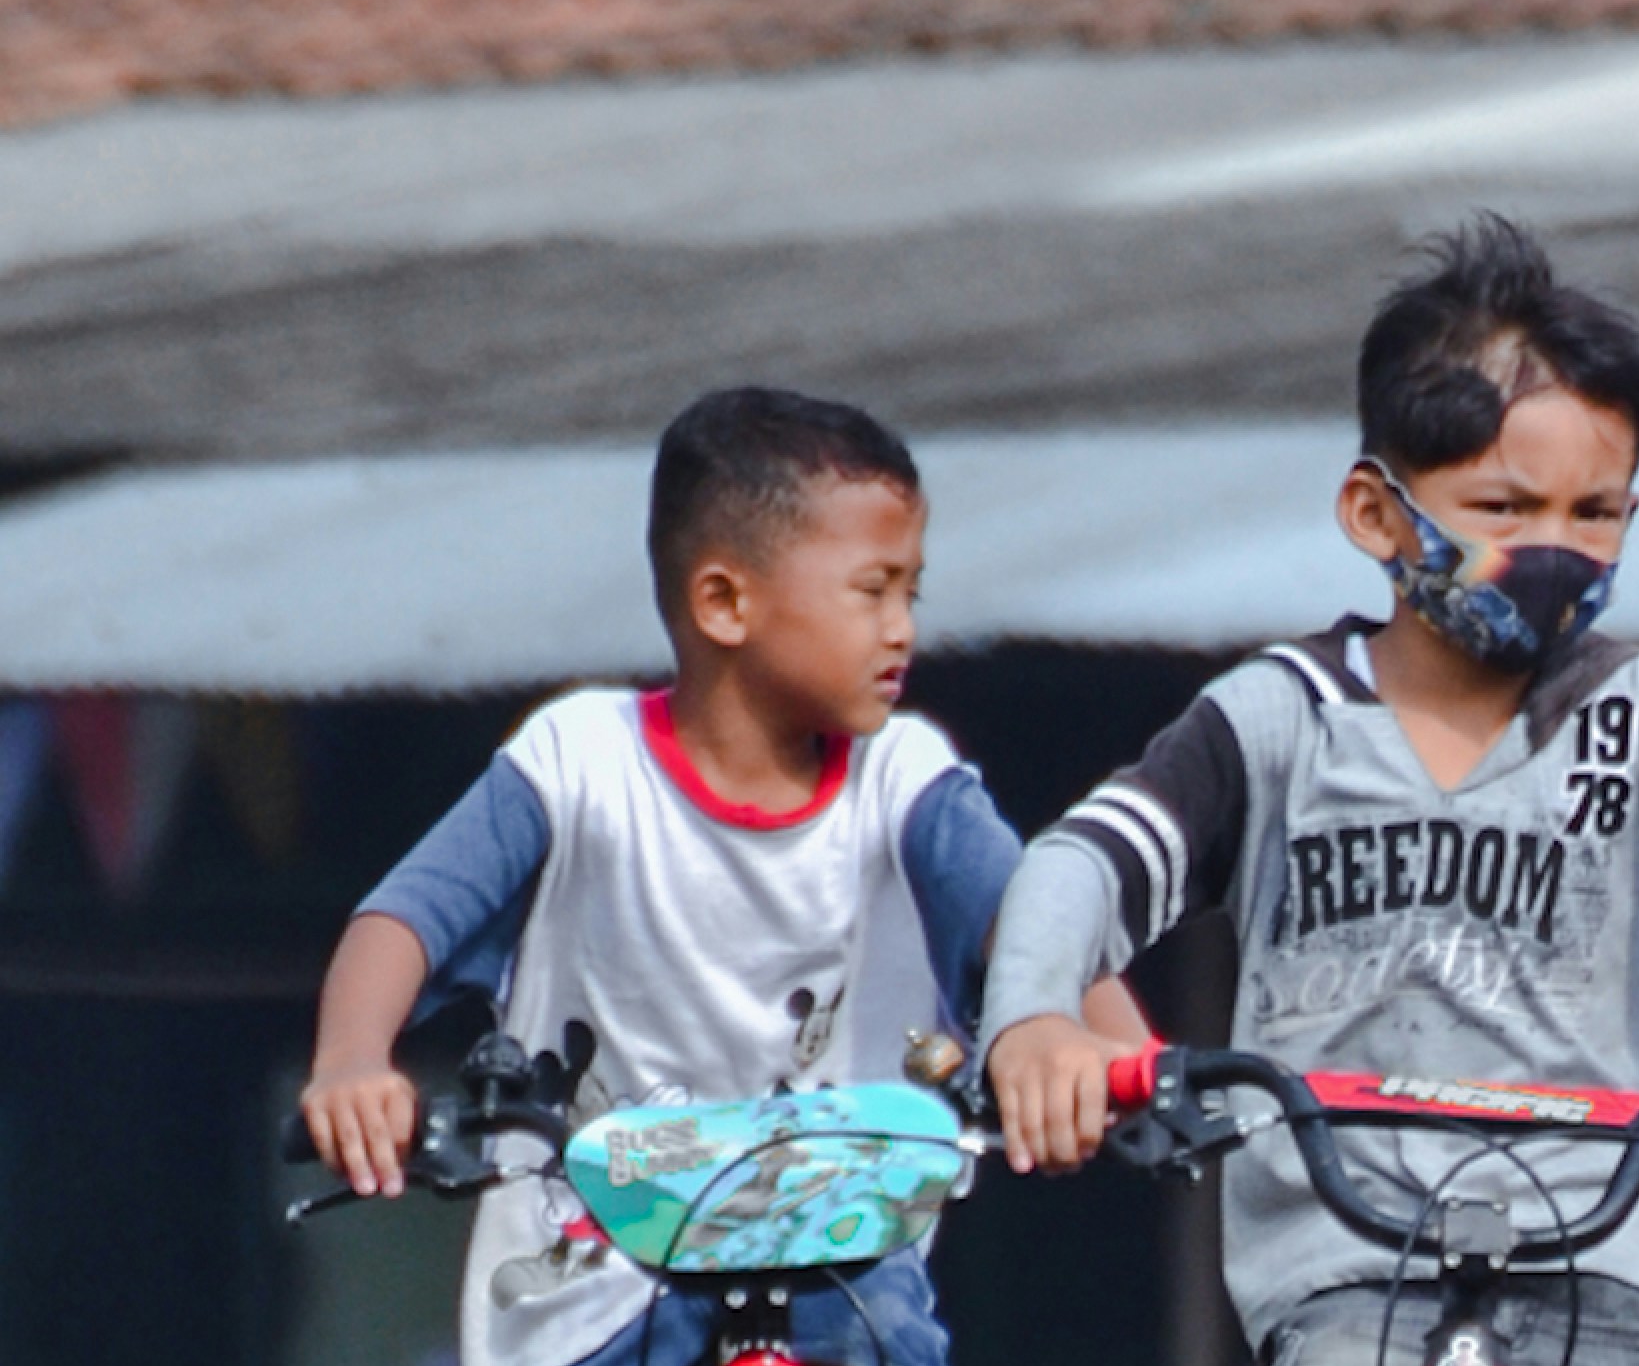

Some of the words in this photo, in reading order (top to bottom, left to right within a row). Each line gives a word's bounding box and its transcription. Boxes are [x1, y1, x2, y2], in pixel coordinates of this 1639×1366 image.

[1576, 696, 1633, 763] 19
[1565, 774, 1630, 836] 78
[1272, 819, 1566, 946] REEDOM
